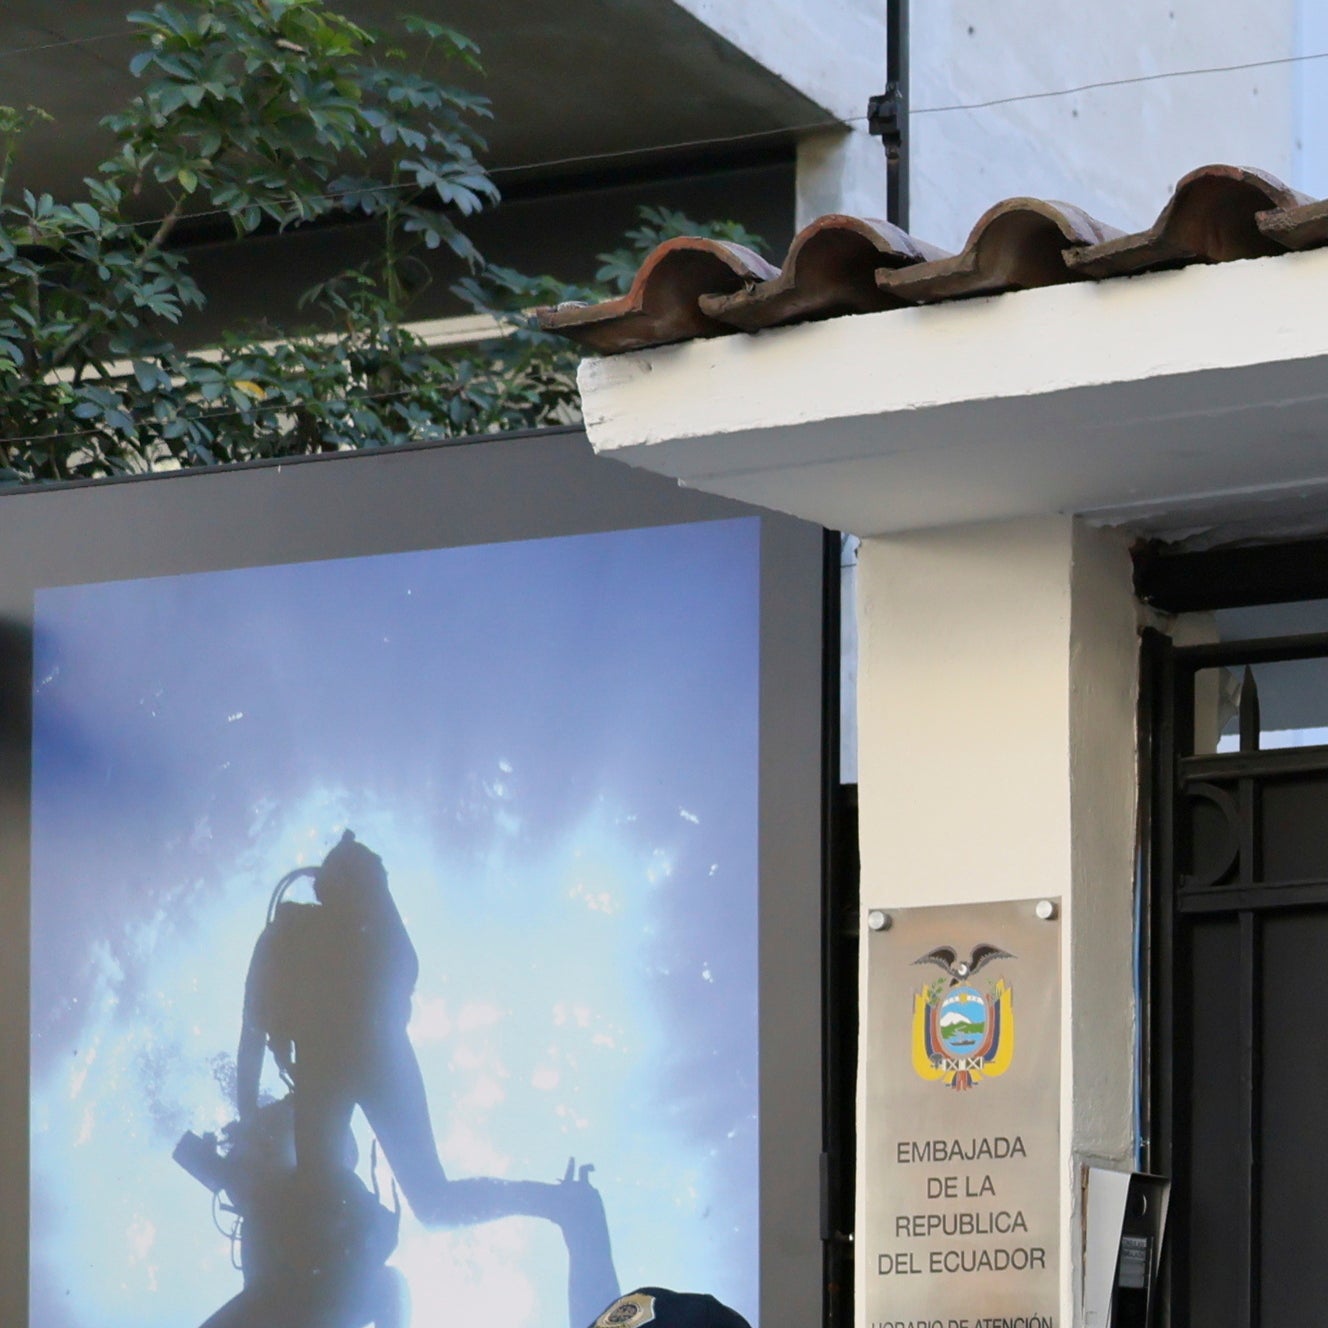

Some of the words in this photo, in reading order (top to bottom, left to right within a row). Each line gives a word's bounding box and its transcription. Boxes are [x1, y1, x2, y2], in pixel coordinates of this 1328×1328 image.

[896, 1135, 1027, 1164] EMBAJADA
[927, 1176, 958, 1199] DE
[965, 1174, 996, 1198] LA
[895, 1210, 1028, 1238] REPUBLICA
[877, 1252, 922, 1276] DEL
[929, 1247, 1046, 1274] ECUADOR
